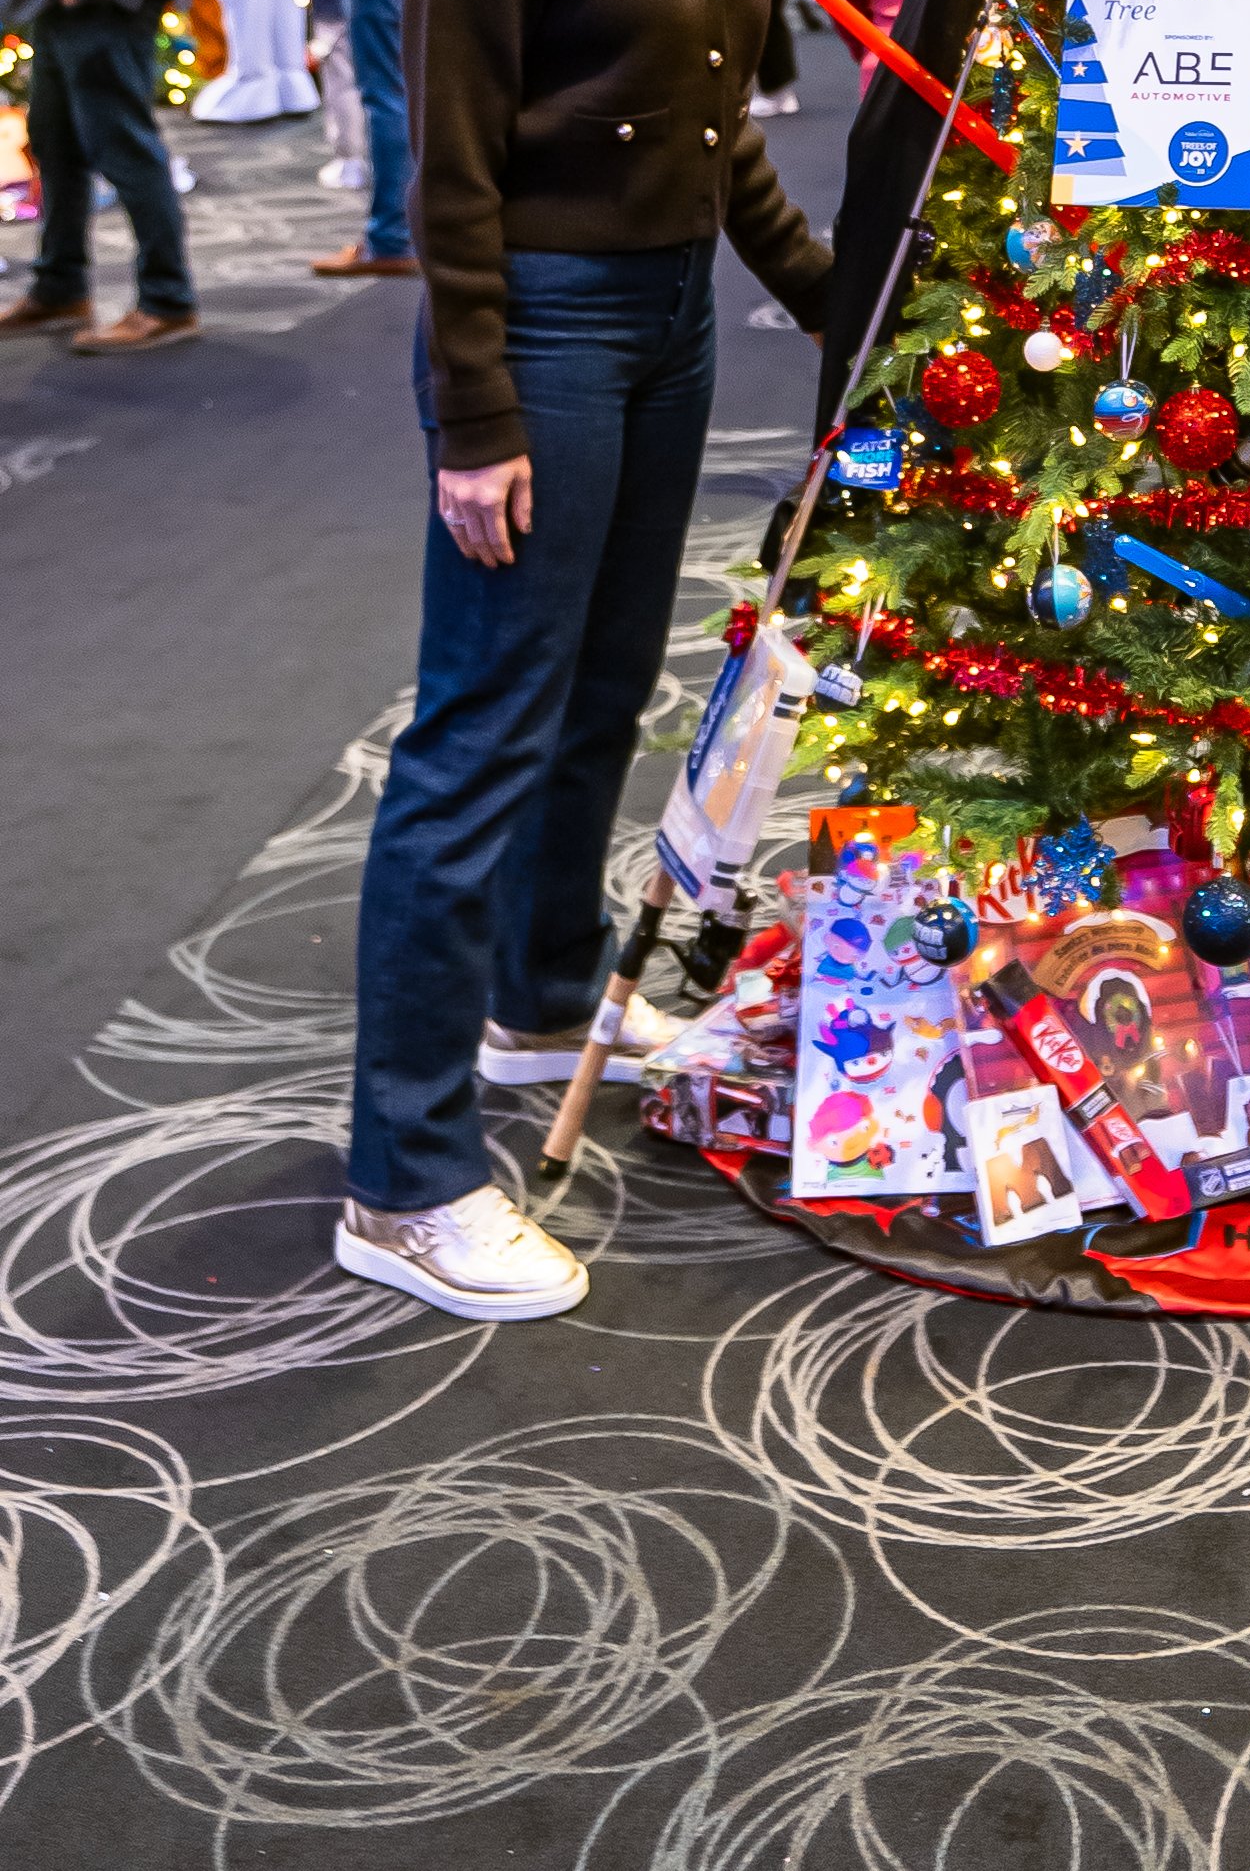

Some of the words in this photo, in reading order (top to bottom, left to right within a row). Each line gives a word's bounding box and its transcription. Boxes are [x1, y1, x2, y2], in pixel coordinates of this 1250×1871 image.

[1104, 0, 1156, 20] Tree
[1133, 51, 1233, 86] ABE
[1131, 92, 1231, 102] AUTOMOTIVE
[1179, 150, 1218, 168] JOY
[846, 462, 893, 479] FISH
